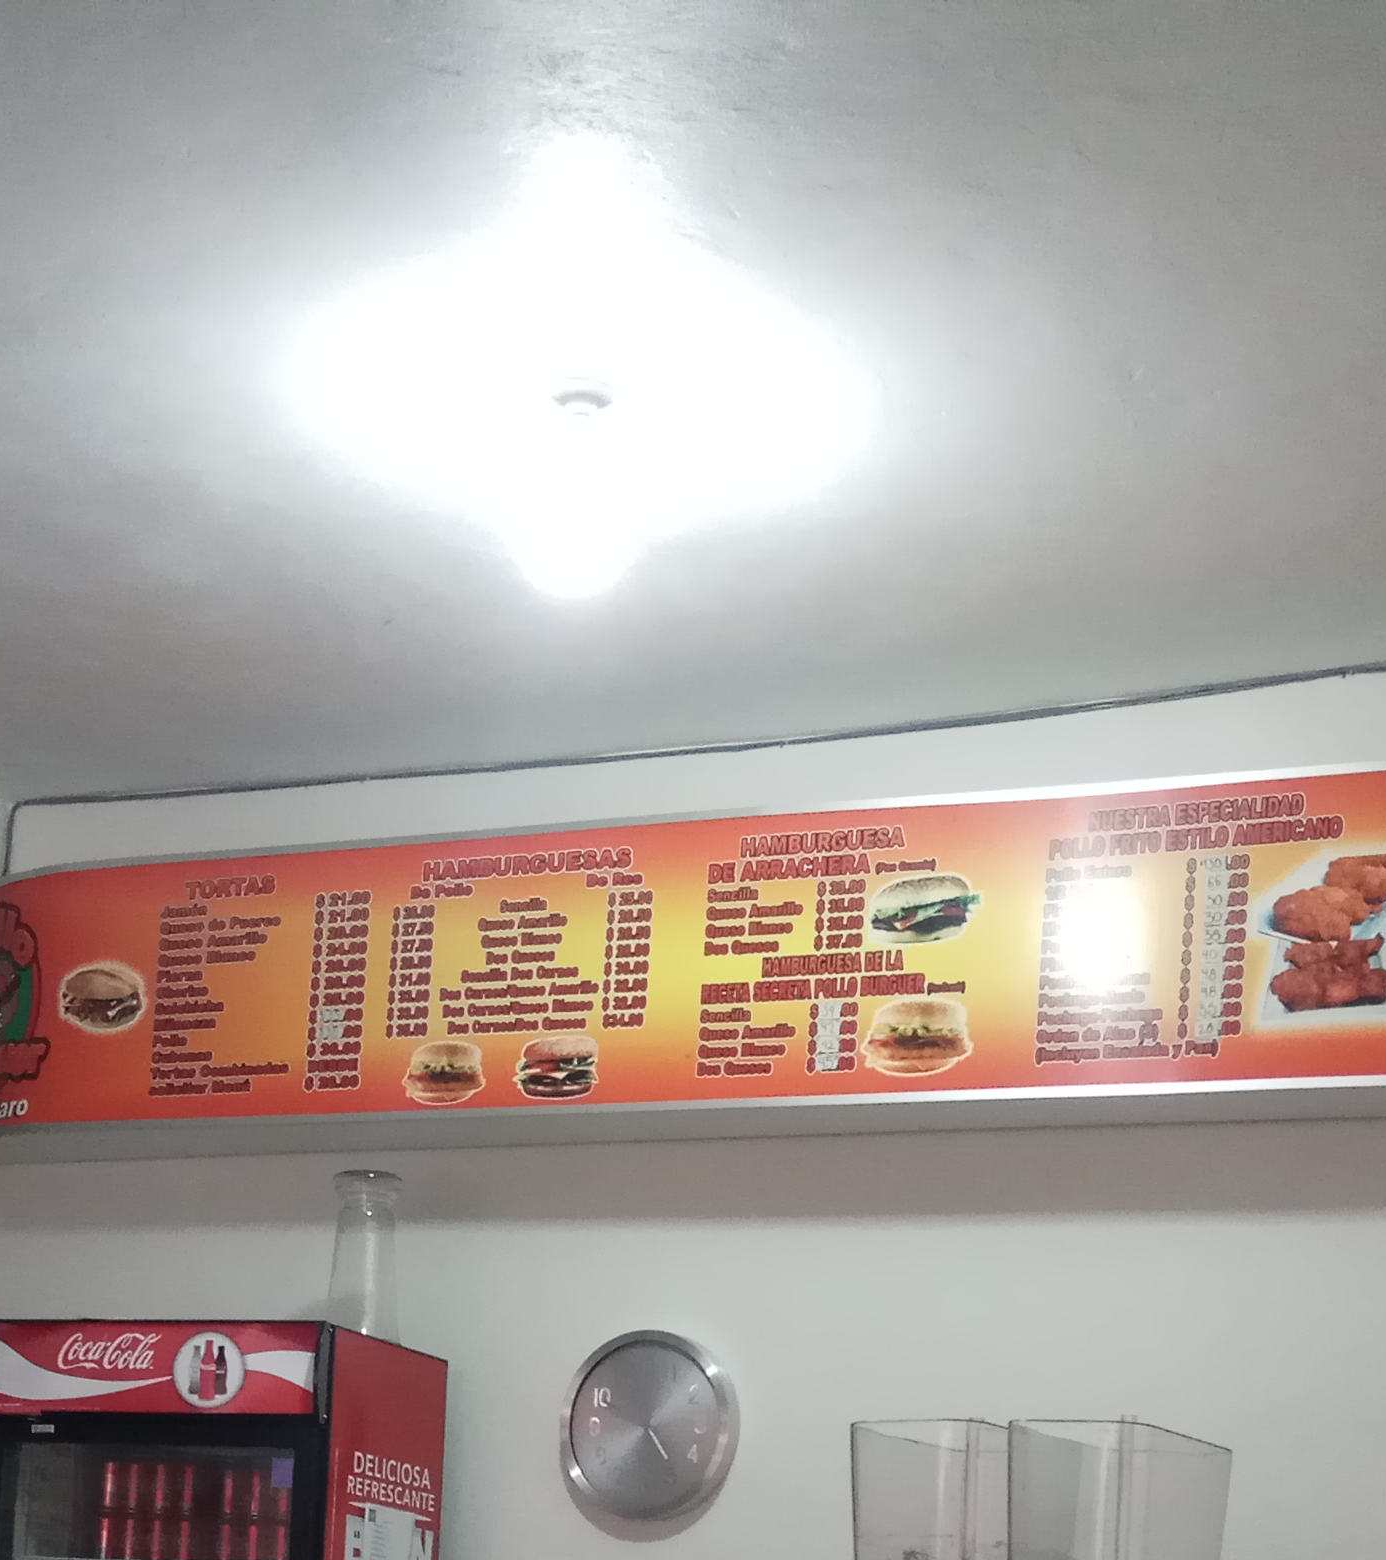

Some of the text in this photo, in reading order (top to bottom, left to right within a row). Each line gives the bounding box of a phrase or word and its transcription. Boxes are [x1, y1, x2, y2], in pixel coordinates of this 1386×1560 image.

[1089, 793, 1304, 832] NUESTRA ESPECIALIDAD
[741, 827, 904, 857] HAMBURGUESA
[1050, 816, 1342, 860] POLLO FRITO ESTILO AMERICANO
[424, 848, 632, 882] HAMBURGUESAS
[709, 855, 870, 884] DE ARRACHERA
[186, 876, 275, 899] TORTAS
[411, 884, 472, 898] De Pollo
[587, 875, 607, 887] De
[708, 888, 758, 901] Sencilla
[707, 903, 802, 920] Queso Amarillo
[706, 922, 792, 937] Queso Blanco
[705, 941, 778, 955] Dos Quesos
[763, 950, 903, 977] HAMBURGUESA DE LA
[702, 983, 750, 1003] RECETA
[754, 980, 811, 1001] SECRETA
[815, 978, 857, 998] POLLO
[861, 974, 925, 996] BURGUER
[701, 1010, 751, 1023] Sencilla
[700, 1024, 795, 1040] Queso Amarillo
[698, 1044, 785, 1058] Queso Blanco
[697, 1062, 771, 1076] Dos Quesos
[353, 1451, 432, 1490] DELICIOSA
[346, 1474, 436, 1512] REFRESCANTE
